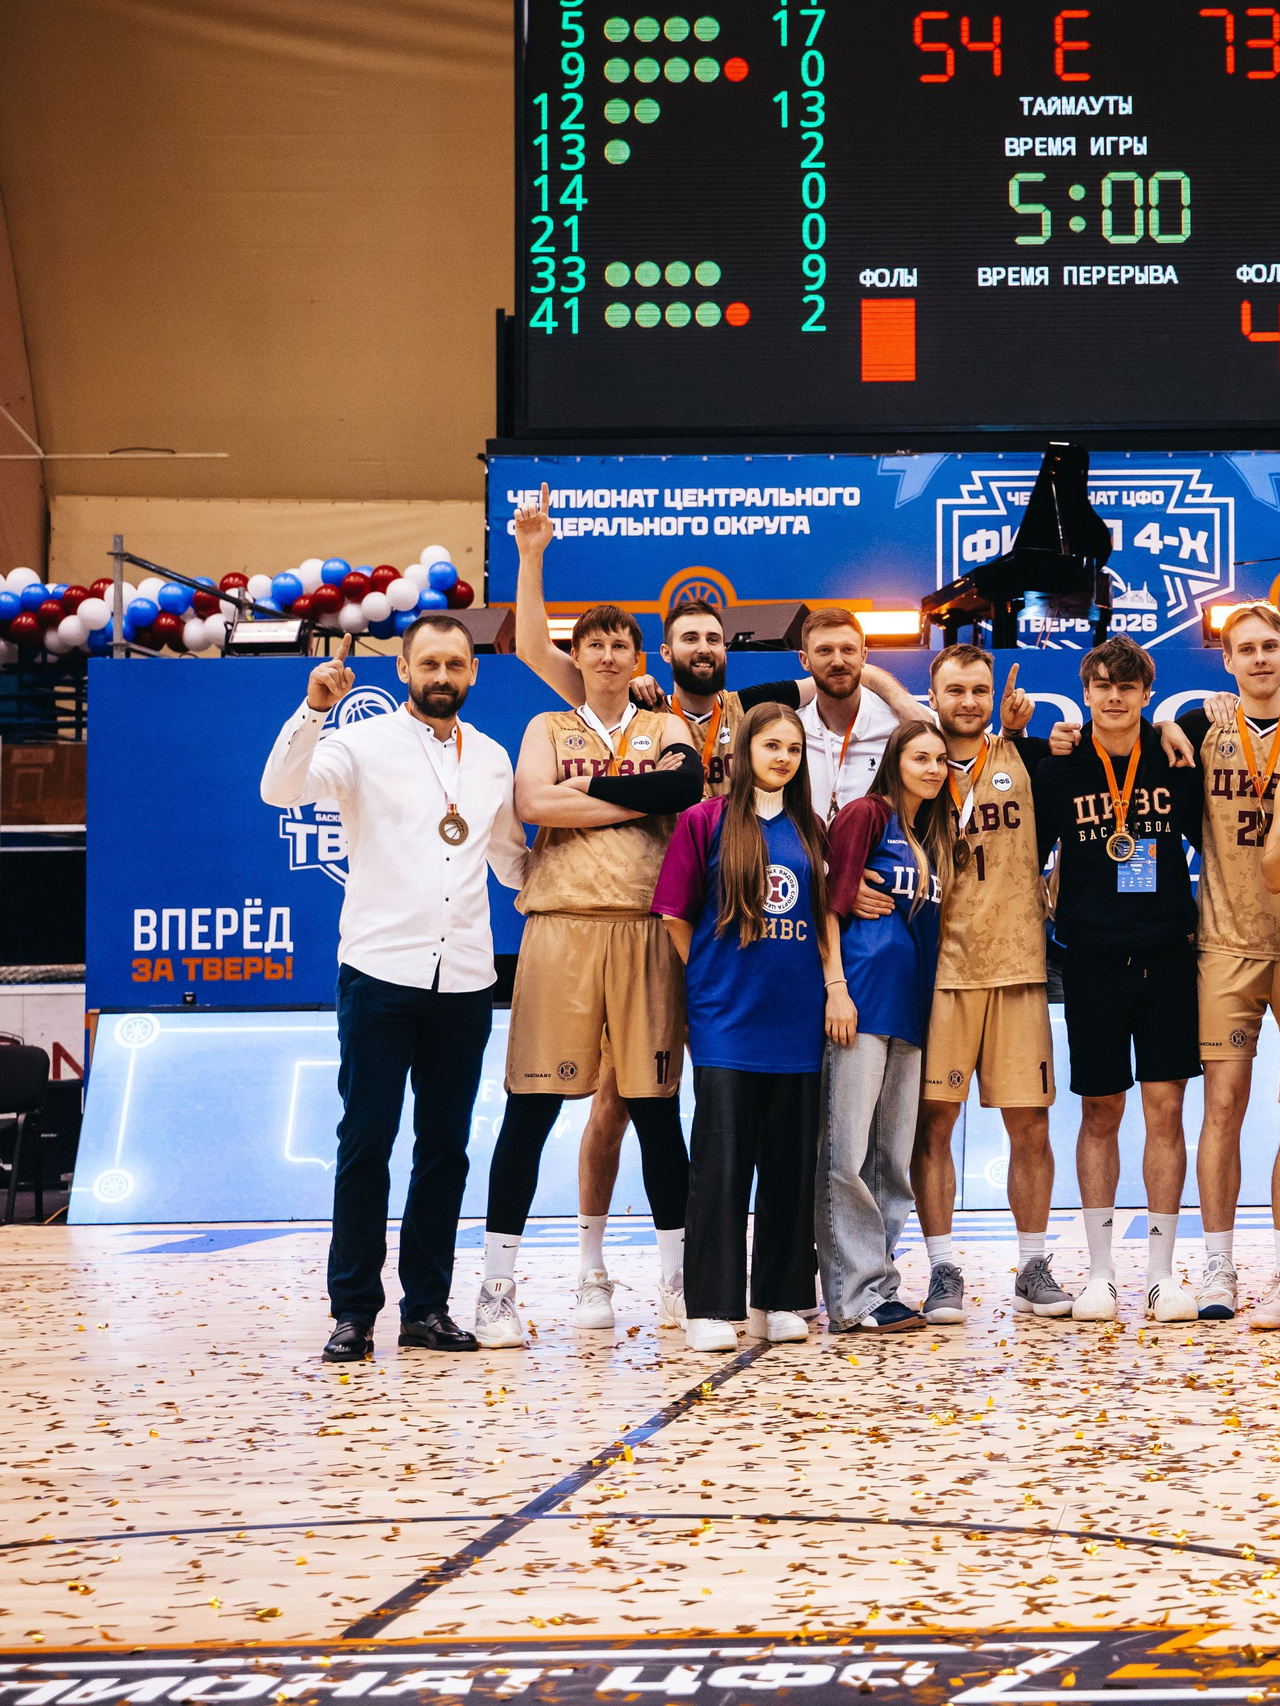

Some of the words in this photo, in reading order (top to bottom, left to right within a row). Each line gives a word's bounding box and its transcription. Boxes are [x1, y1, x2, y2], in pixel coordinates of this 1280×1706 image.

[561, 11, 585, 48] 5
[772, 9, 826, 47] 17
[913, 11, 1002, 83] 54
[561, 52, 585, 89] 9
[800, 50, 825, 87] 0
[533, 93, 586, 130] 12
[772, 91, 826, 128] 13
[1019, 96, 1133, 116] ТАЙМАУТЫ
[533, 134, 586, 171] 13
[800, 131, 826, 169] 2
[1004, 136, 1077, 157] ВРЕМЯ
[1090, 136, 1148, 156] ИГРЫ
[533, 174, 588, 211] 14
[801, 172, 826, 210] 0
[1008, 172, 1191, 245] 5:00
[530, 215, 579, 252] 21
[801, 212, 826, 250] 0
[530, 256, 586, 293] 33
[802, 254, 827, 291] 9
[859, 267, 918, 288] ФОЛЫ
[977, 266, 1049, 287] ВРЕМЯ
[1063, 265, 1179, 286] ПЕРЕРЫВА
[529, 297, 580, 334] 41
[801, 294, 827, 332] 2
[664, 487, 860, 511] ЦЕНТРАЛЬНОГО
[1121, 489, 1165, 506] ЦФО
[507, 516, 709, 540] ДЕРАЛЬНОГО
[714, 515, 811, 535] ОКРУГА
[972, 844, 986, 882] 1
[133, 898, 294, 953] ВПЕРЁД
[131, 957, 175, 982] ЗА
[182, 956, 293, 981] ТВЕРЬ!
[654, 1050, 671, 1085] 11
[1039, 1061, 1048, 1094] 1
